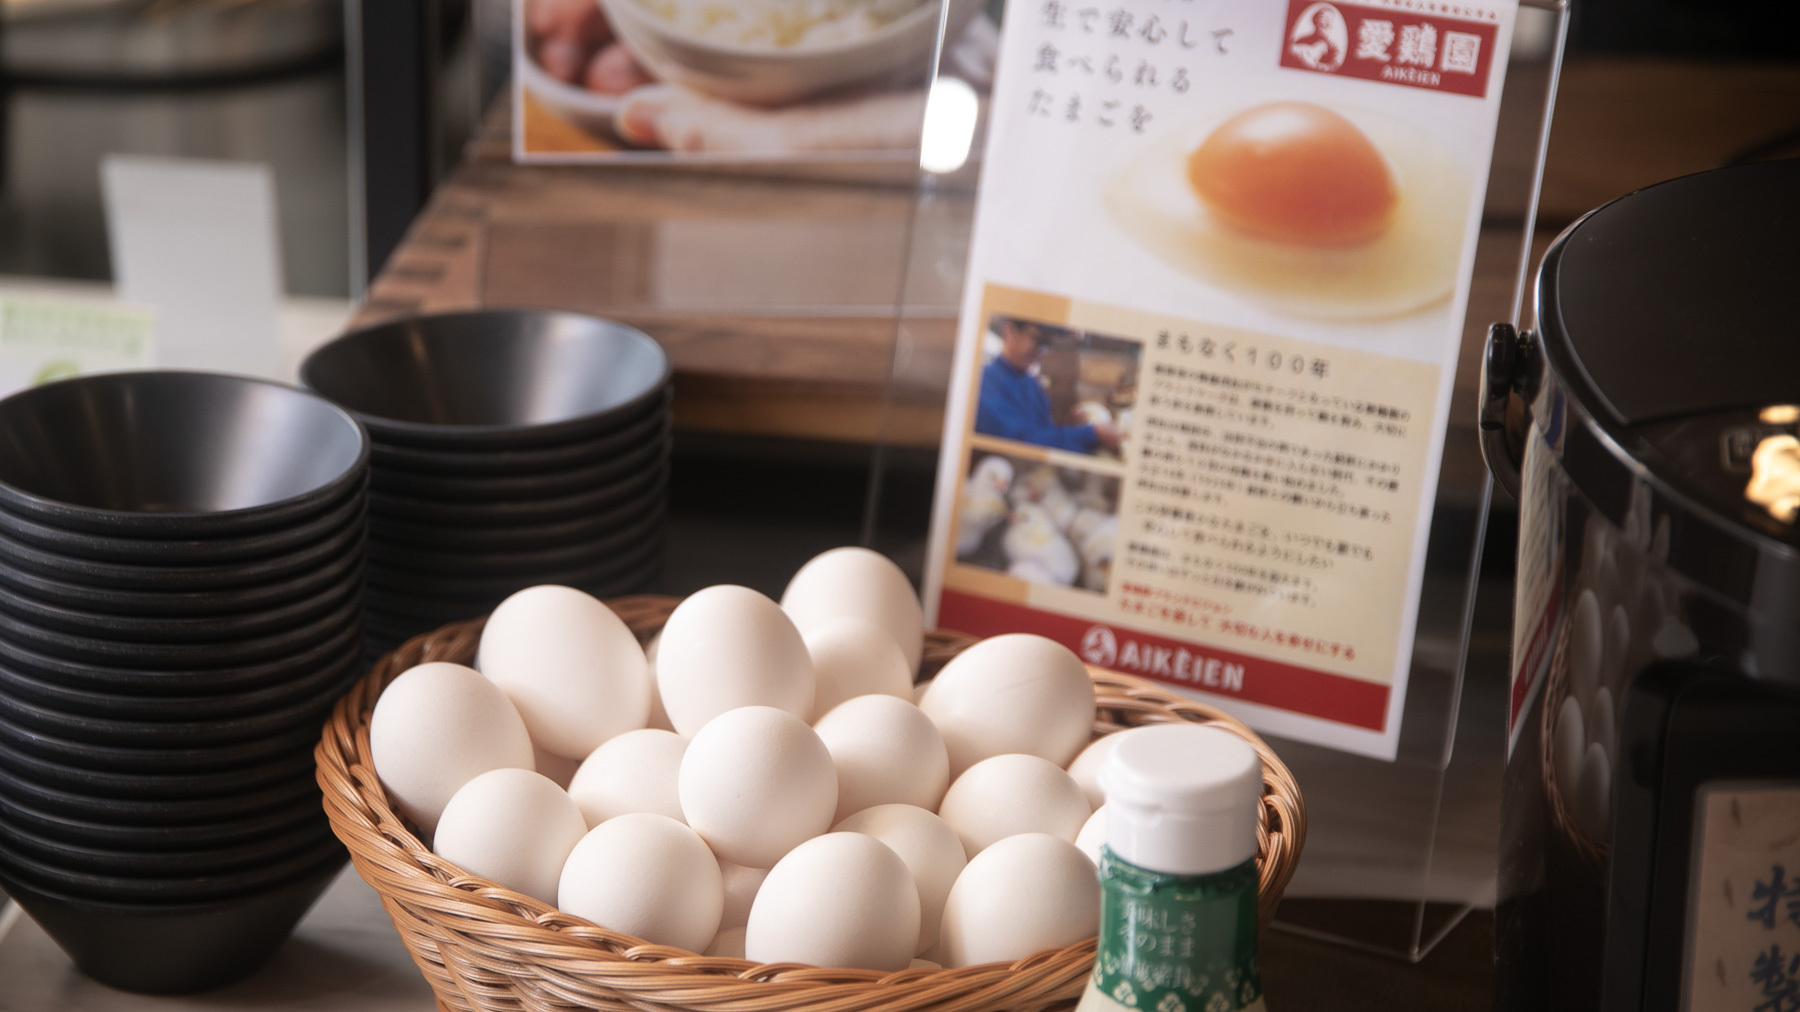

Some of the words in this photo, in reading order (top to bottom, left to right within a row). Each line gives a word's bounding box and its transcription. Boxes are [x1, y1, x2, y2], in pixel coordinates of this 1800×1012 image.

[1040, 0, 1234, 54] 生で安心して
[1033, 41, 1191, 93] 食べられる
[1026, 87, 1154, 134] たまごを
